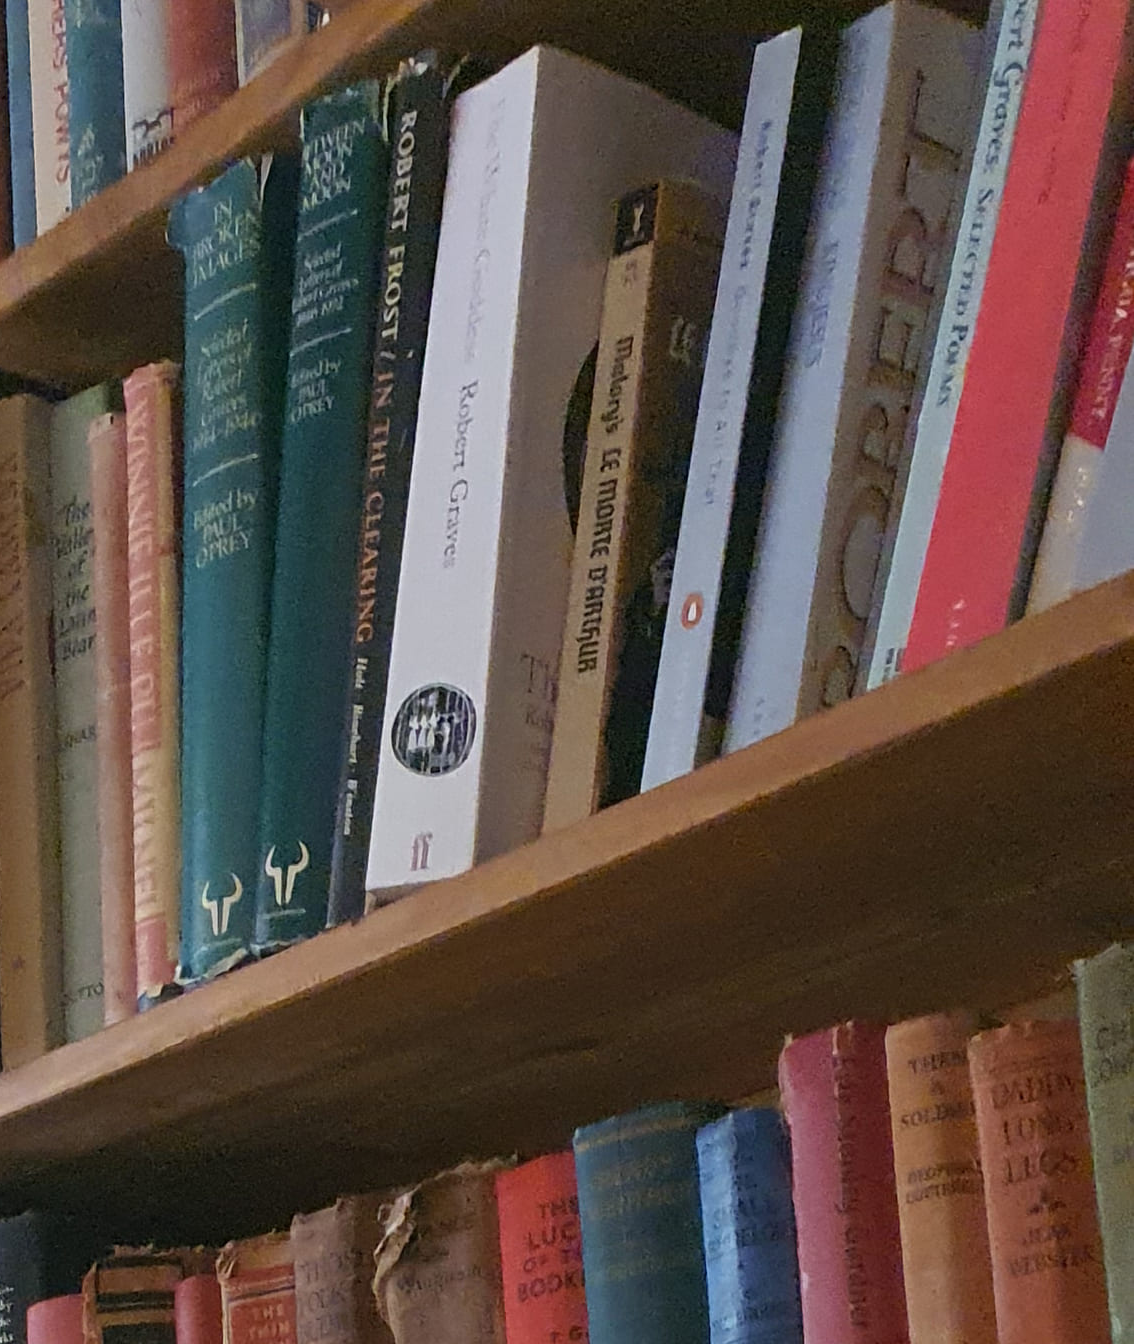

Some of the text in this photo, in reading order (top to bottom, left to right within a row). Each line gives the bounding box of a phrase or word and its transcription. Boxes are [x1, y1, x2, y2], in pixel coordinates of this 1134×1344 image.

[356, 108, 418, 643] ROBERT FROST IN THE CLEARING
[601, 335, 634, 435] Malory's
[443, 382, 479, 571] Robert Graves
[601, 446, 620, 473] LE
[591, 479, 618, 557] MORTE
